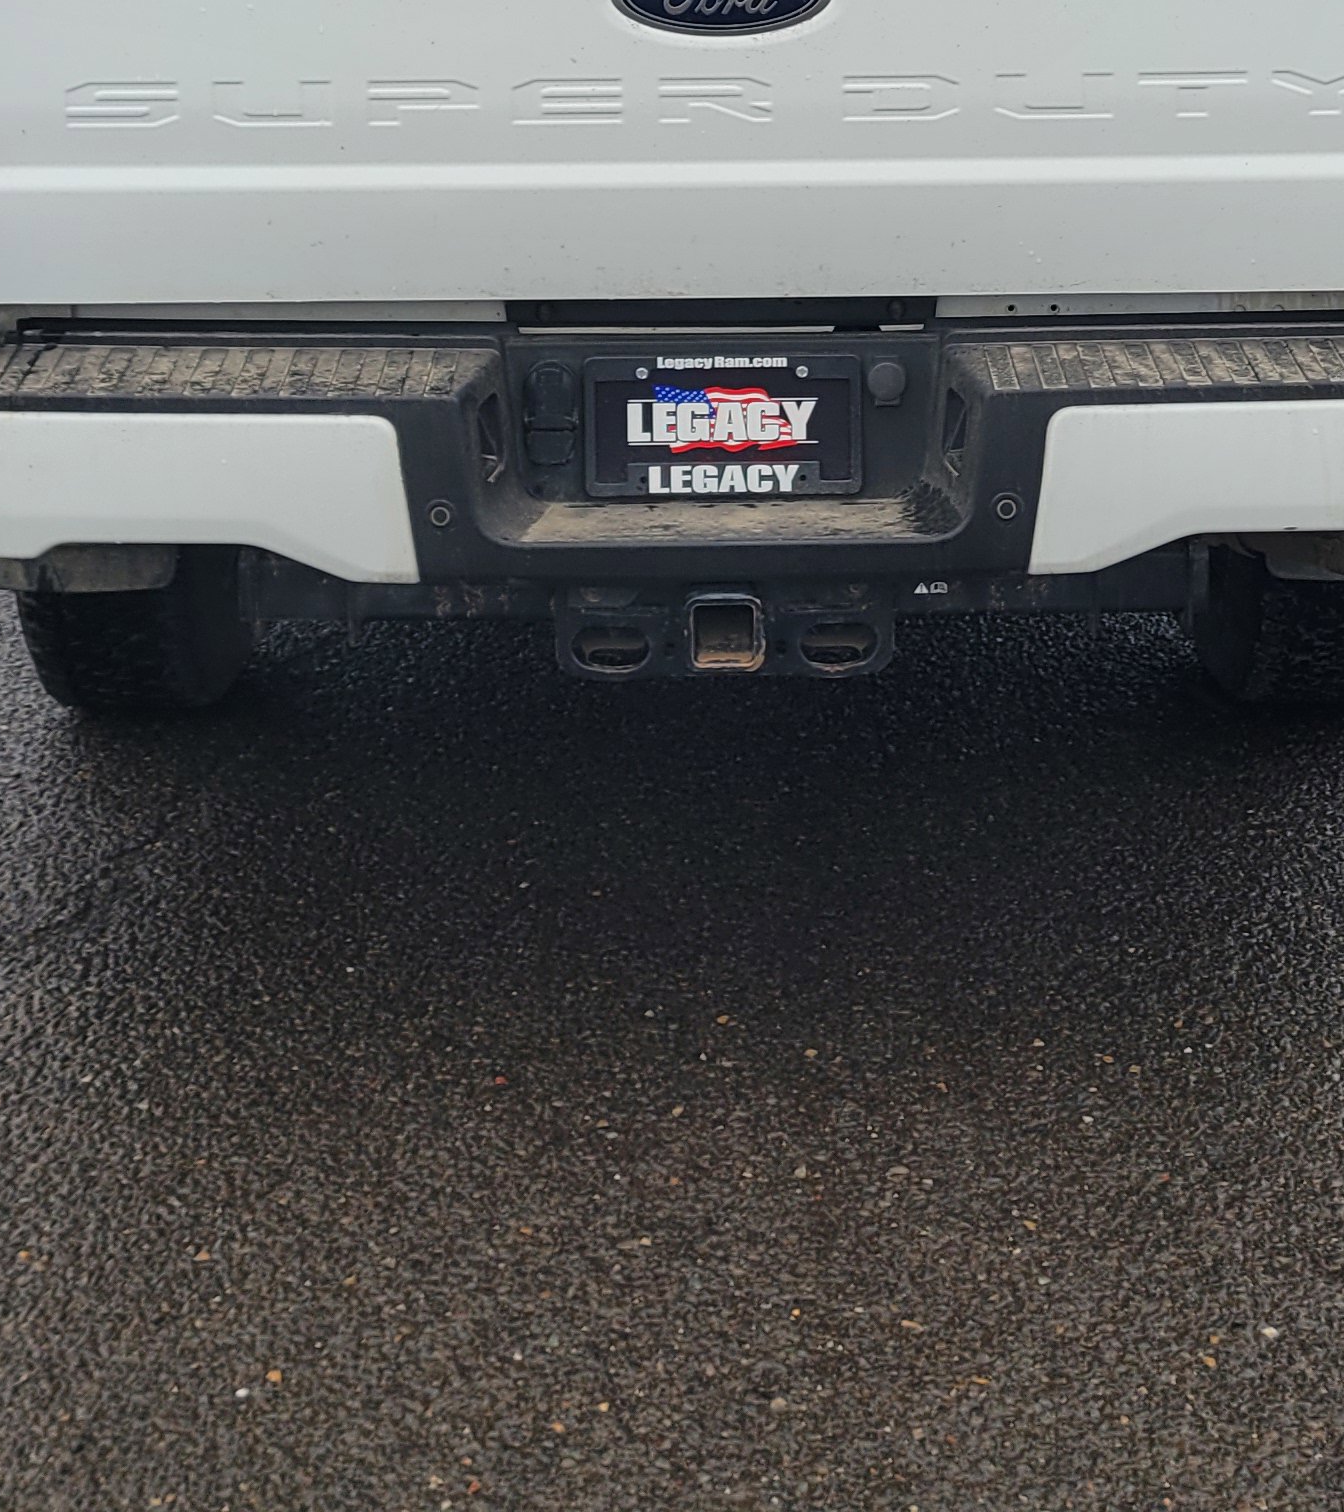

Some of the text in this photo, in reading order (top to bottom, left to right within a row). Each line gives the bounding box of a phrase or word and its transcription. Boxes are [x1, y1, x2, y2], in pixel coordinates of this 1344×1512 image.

[65, 76, 773, 127] SUPER
[626, 401, 817, 443] LEGACY
[648, 465, 800, 494] LEGACY
